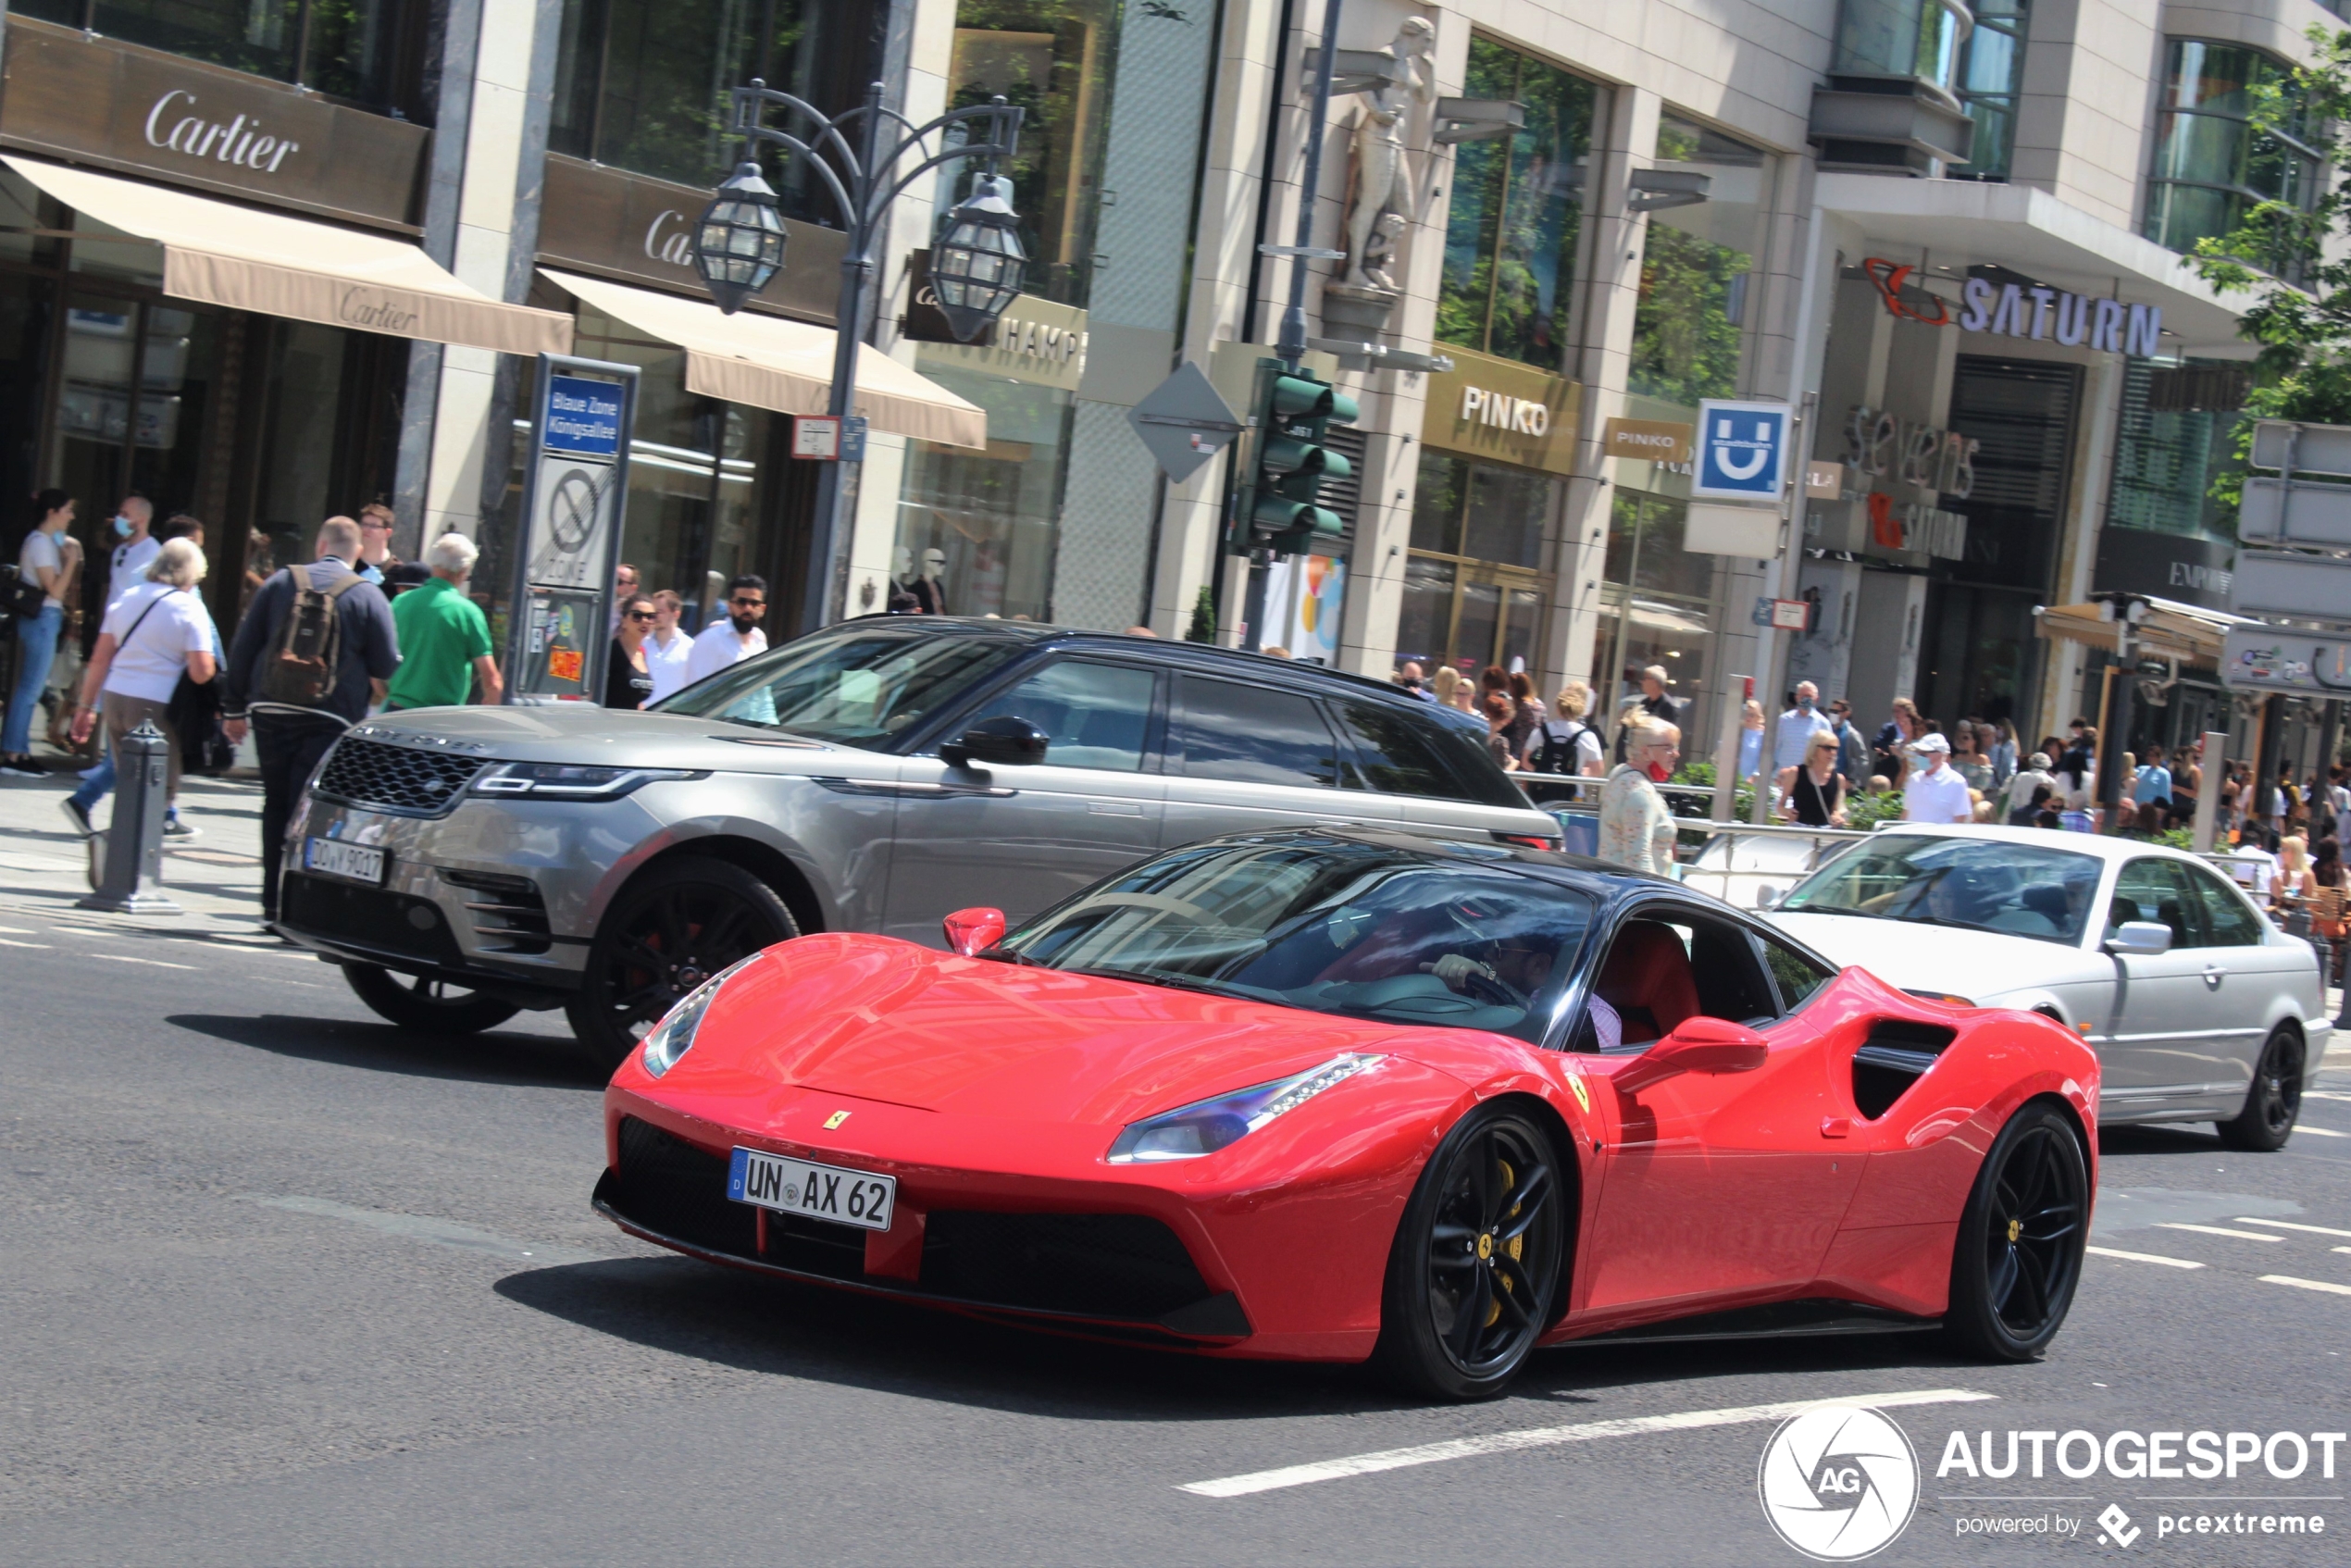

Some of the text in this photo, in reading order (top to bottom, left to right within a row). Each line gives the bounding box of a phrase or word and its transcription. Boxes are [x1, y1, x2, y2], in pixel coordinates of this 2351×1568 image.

[145, 90, 300, 173] Cartier
[339, 285, 418, 330] Cartier
[1959, 278, 2162, 358] SATURN
[1001, 317, 1077, 363] HAMP
[553, 392, 618, 417] Blaue Zone
[1462, 386, 1549, 437] PINKO
[548, 415, 617, 441] Königsallee
[1616, 431, 1675, 448] PINKO
[548, 557, 585, 581] ZONE
[747, 1158, 783, 1201] UN
[802, 1170, 841, 1214] AX
[848, 1180, 887, 1223] 62
